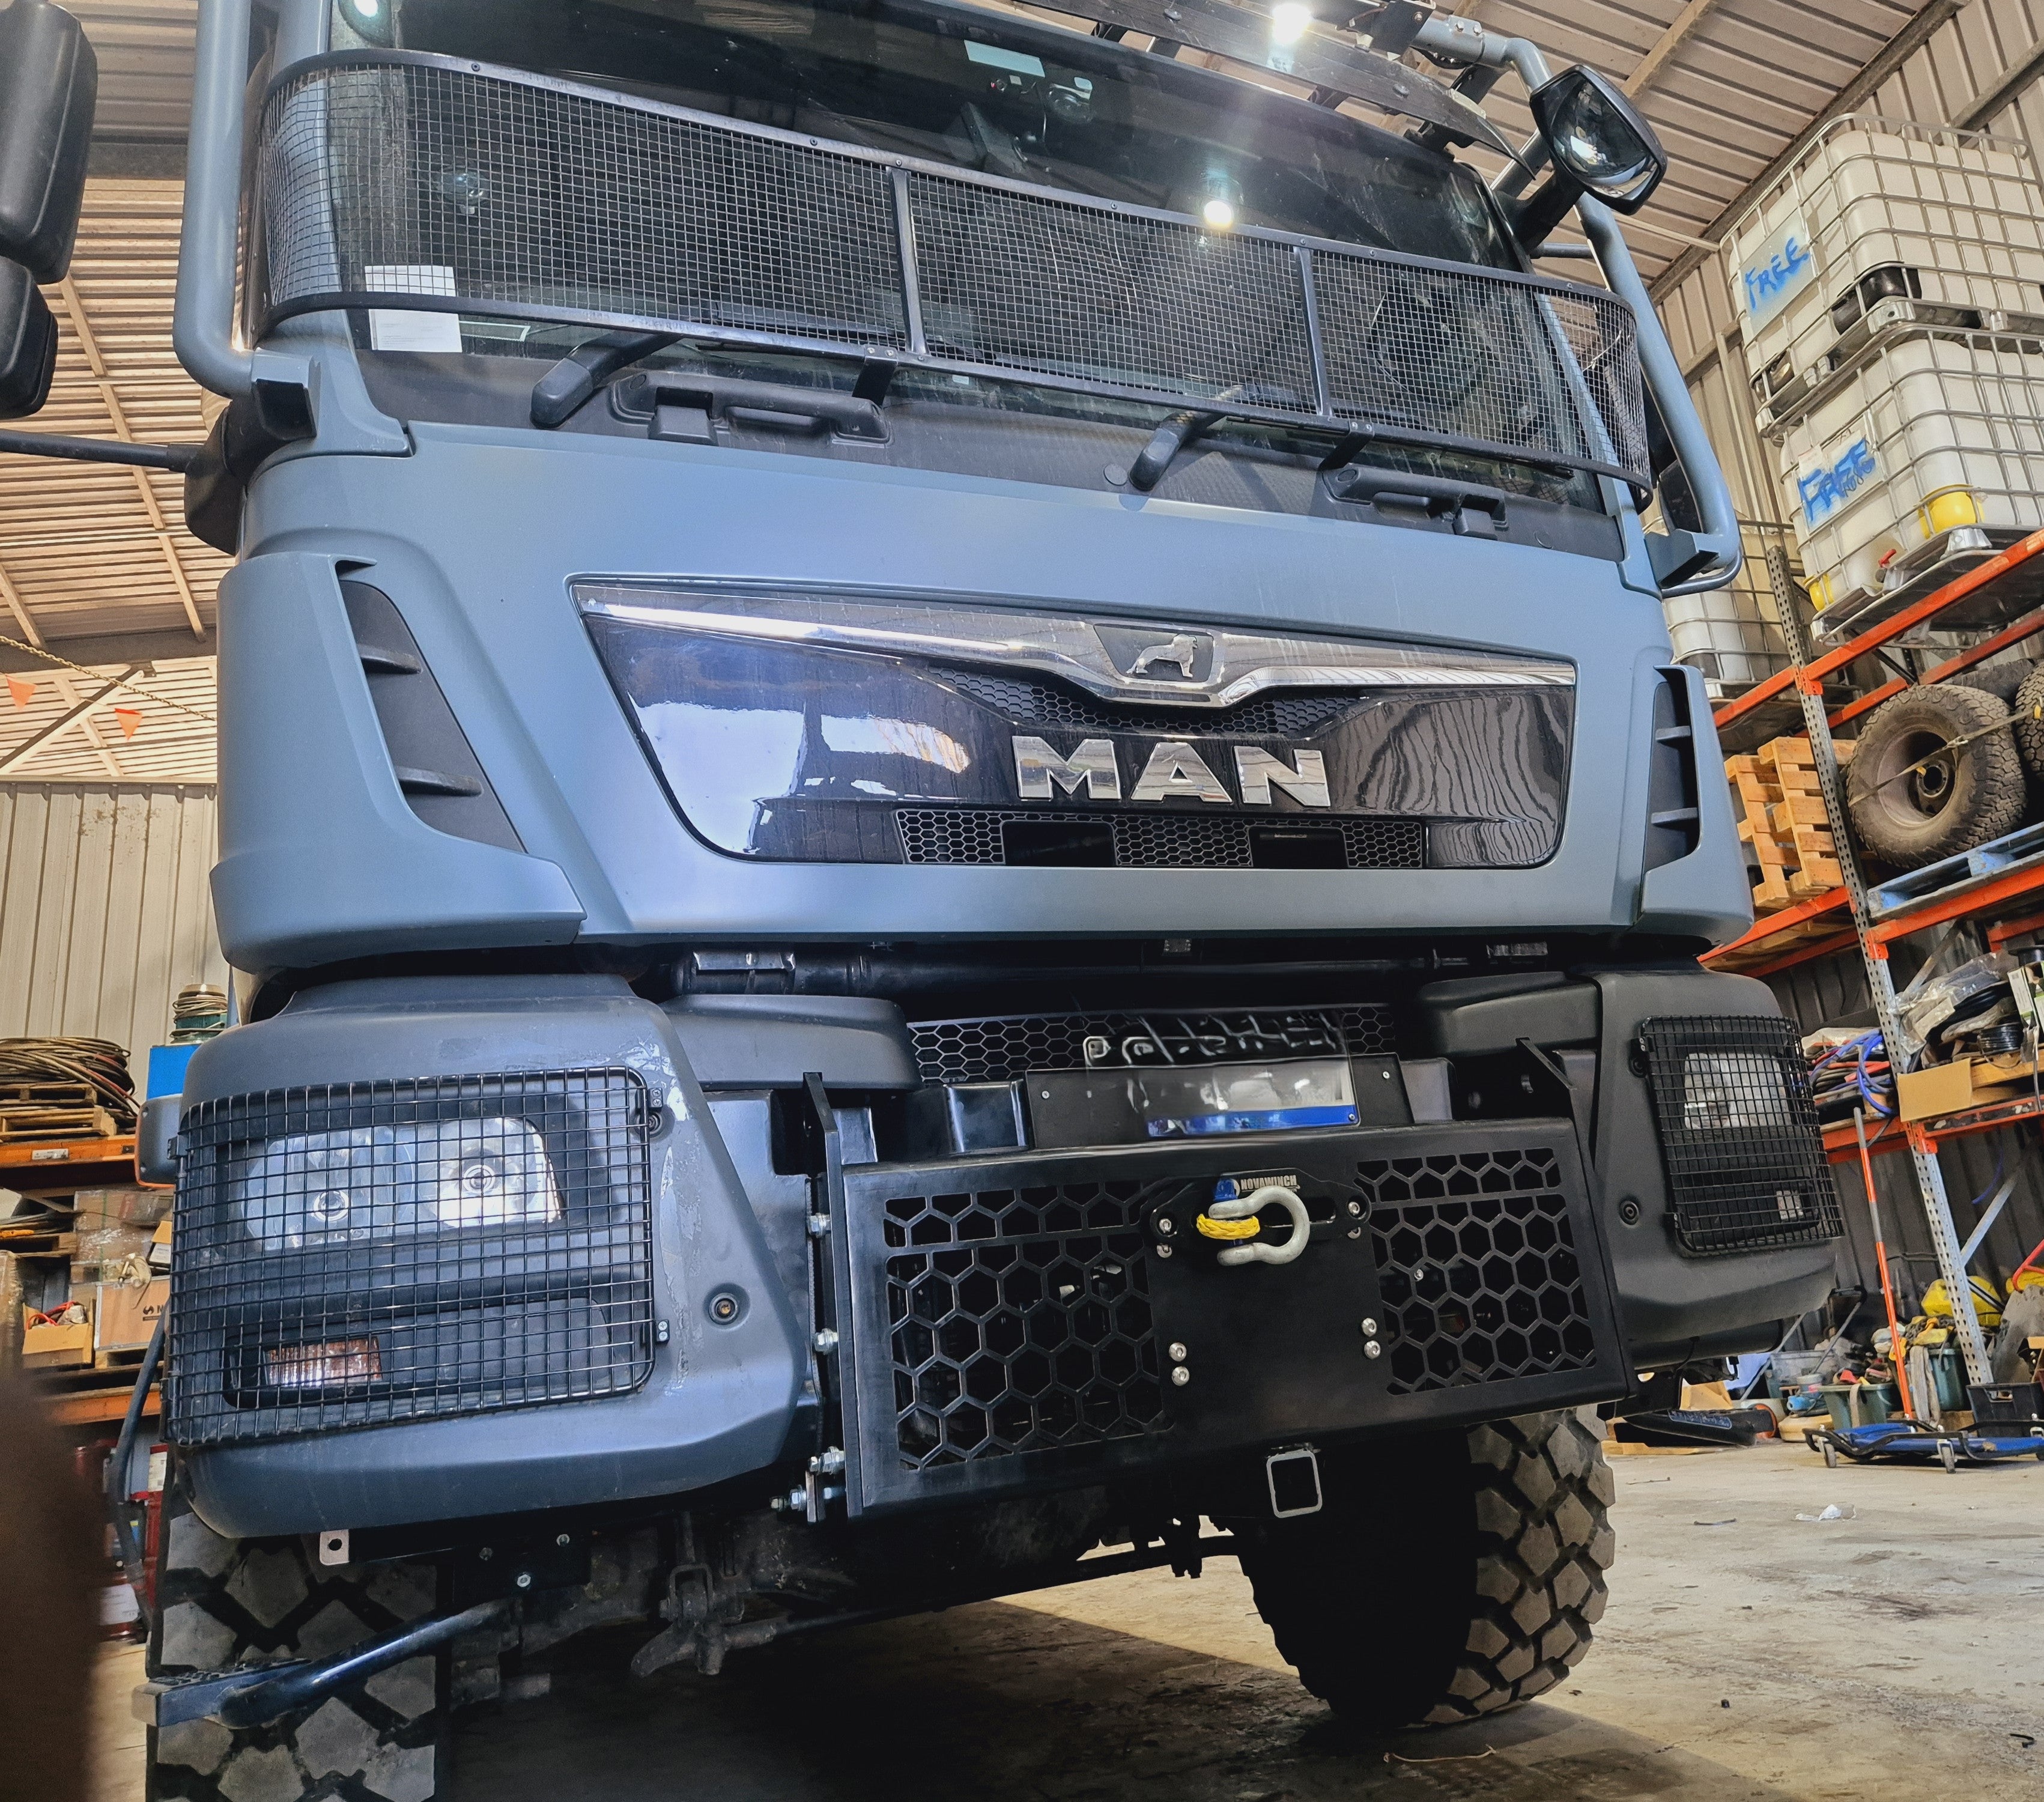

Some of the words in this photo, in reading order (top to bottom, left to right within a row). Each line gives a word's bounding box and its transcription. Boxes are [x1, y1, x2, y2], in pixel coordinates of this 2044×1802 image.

[1745, 237, 1809, 309] FREE
[1011, 736, 1330, 807] MAN
[1241, 1175, 1297, 1190] NOVAWINCH
